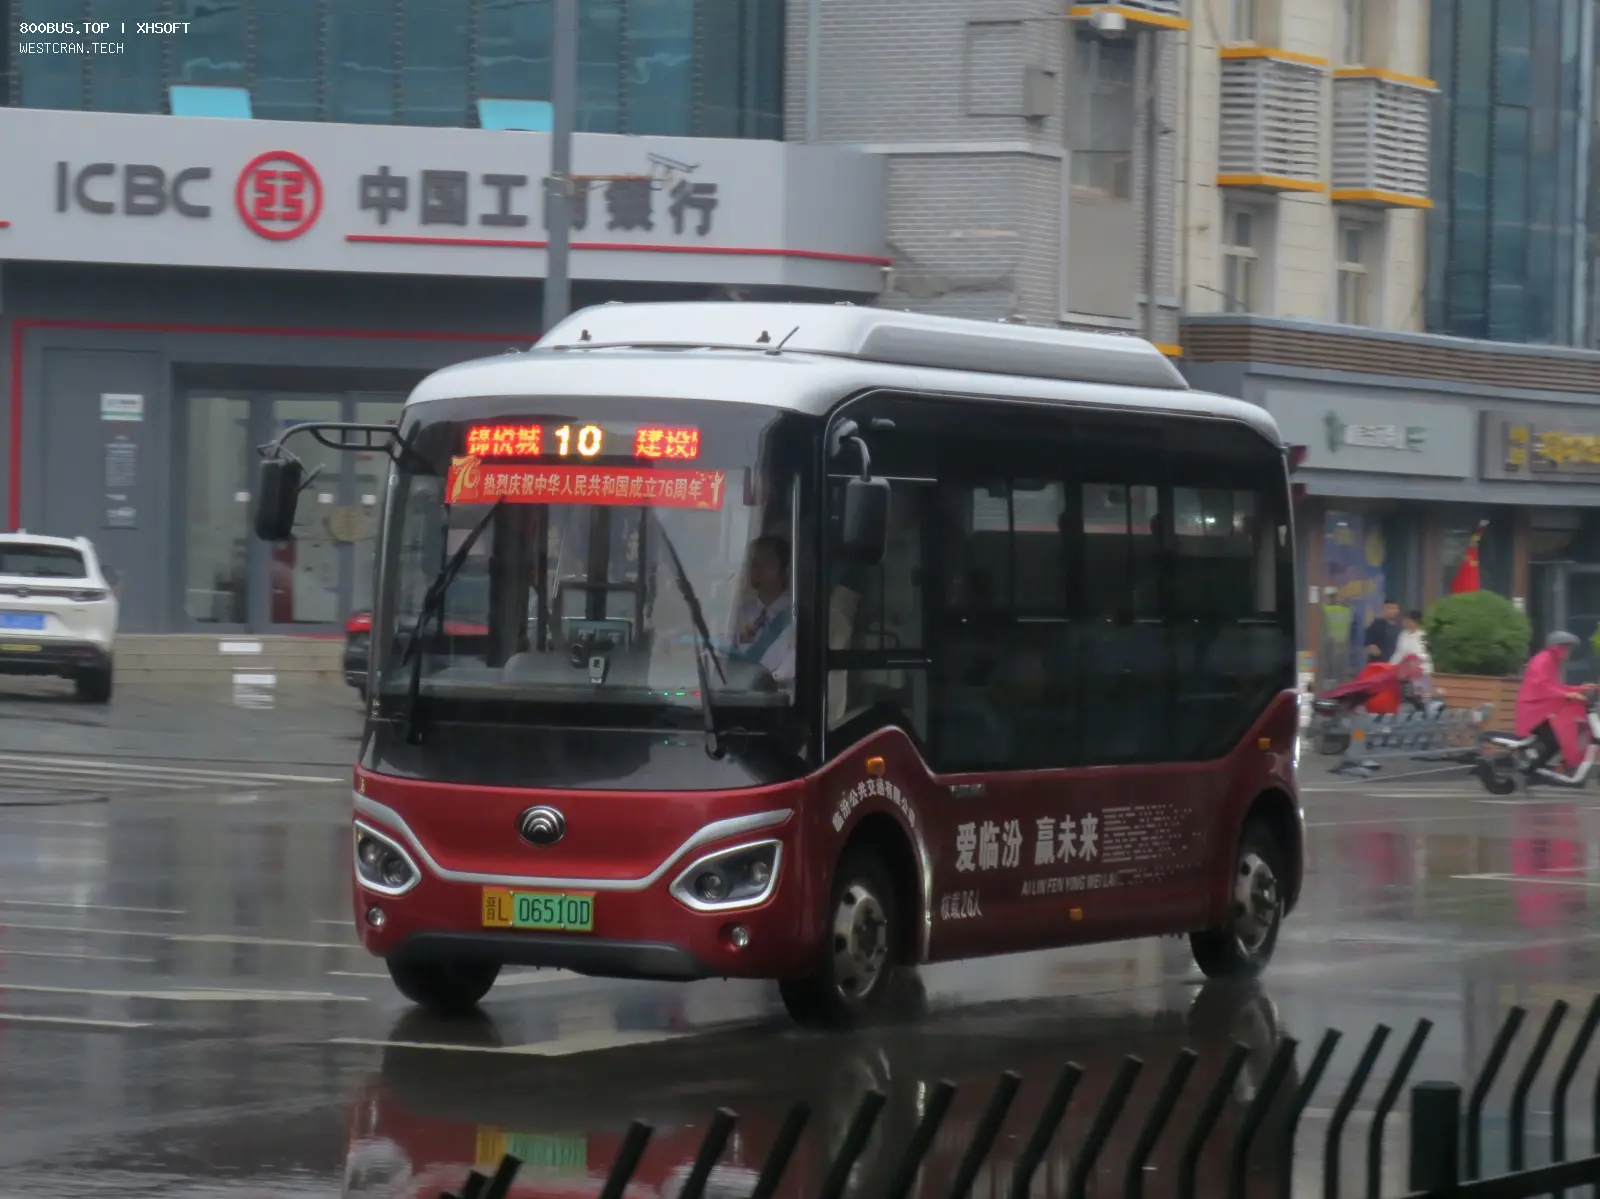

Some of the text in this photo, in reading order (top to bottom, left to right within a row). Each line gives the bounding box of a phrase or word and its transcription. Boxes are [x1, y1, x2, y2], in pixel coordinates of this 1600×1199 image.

[56, 160, 212, 218] ICBC
[555, 425, 602, 456] 10
[483, 472, 702, 501] 热烈庆祝中华人民共和国成立76周年
[955, 813, 1099, 872] 爱临汾 赢未来
